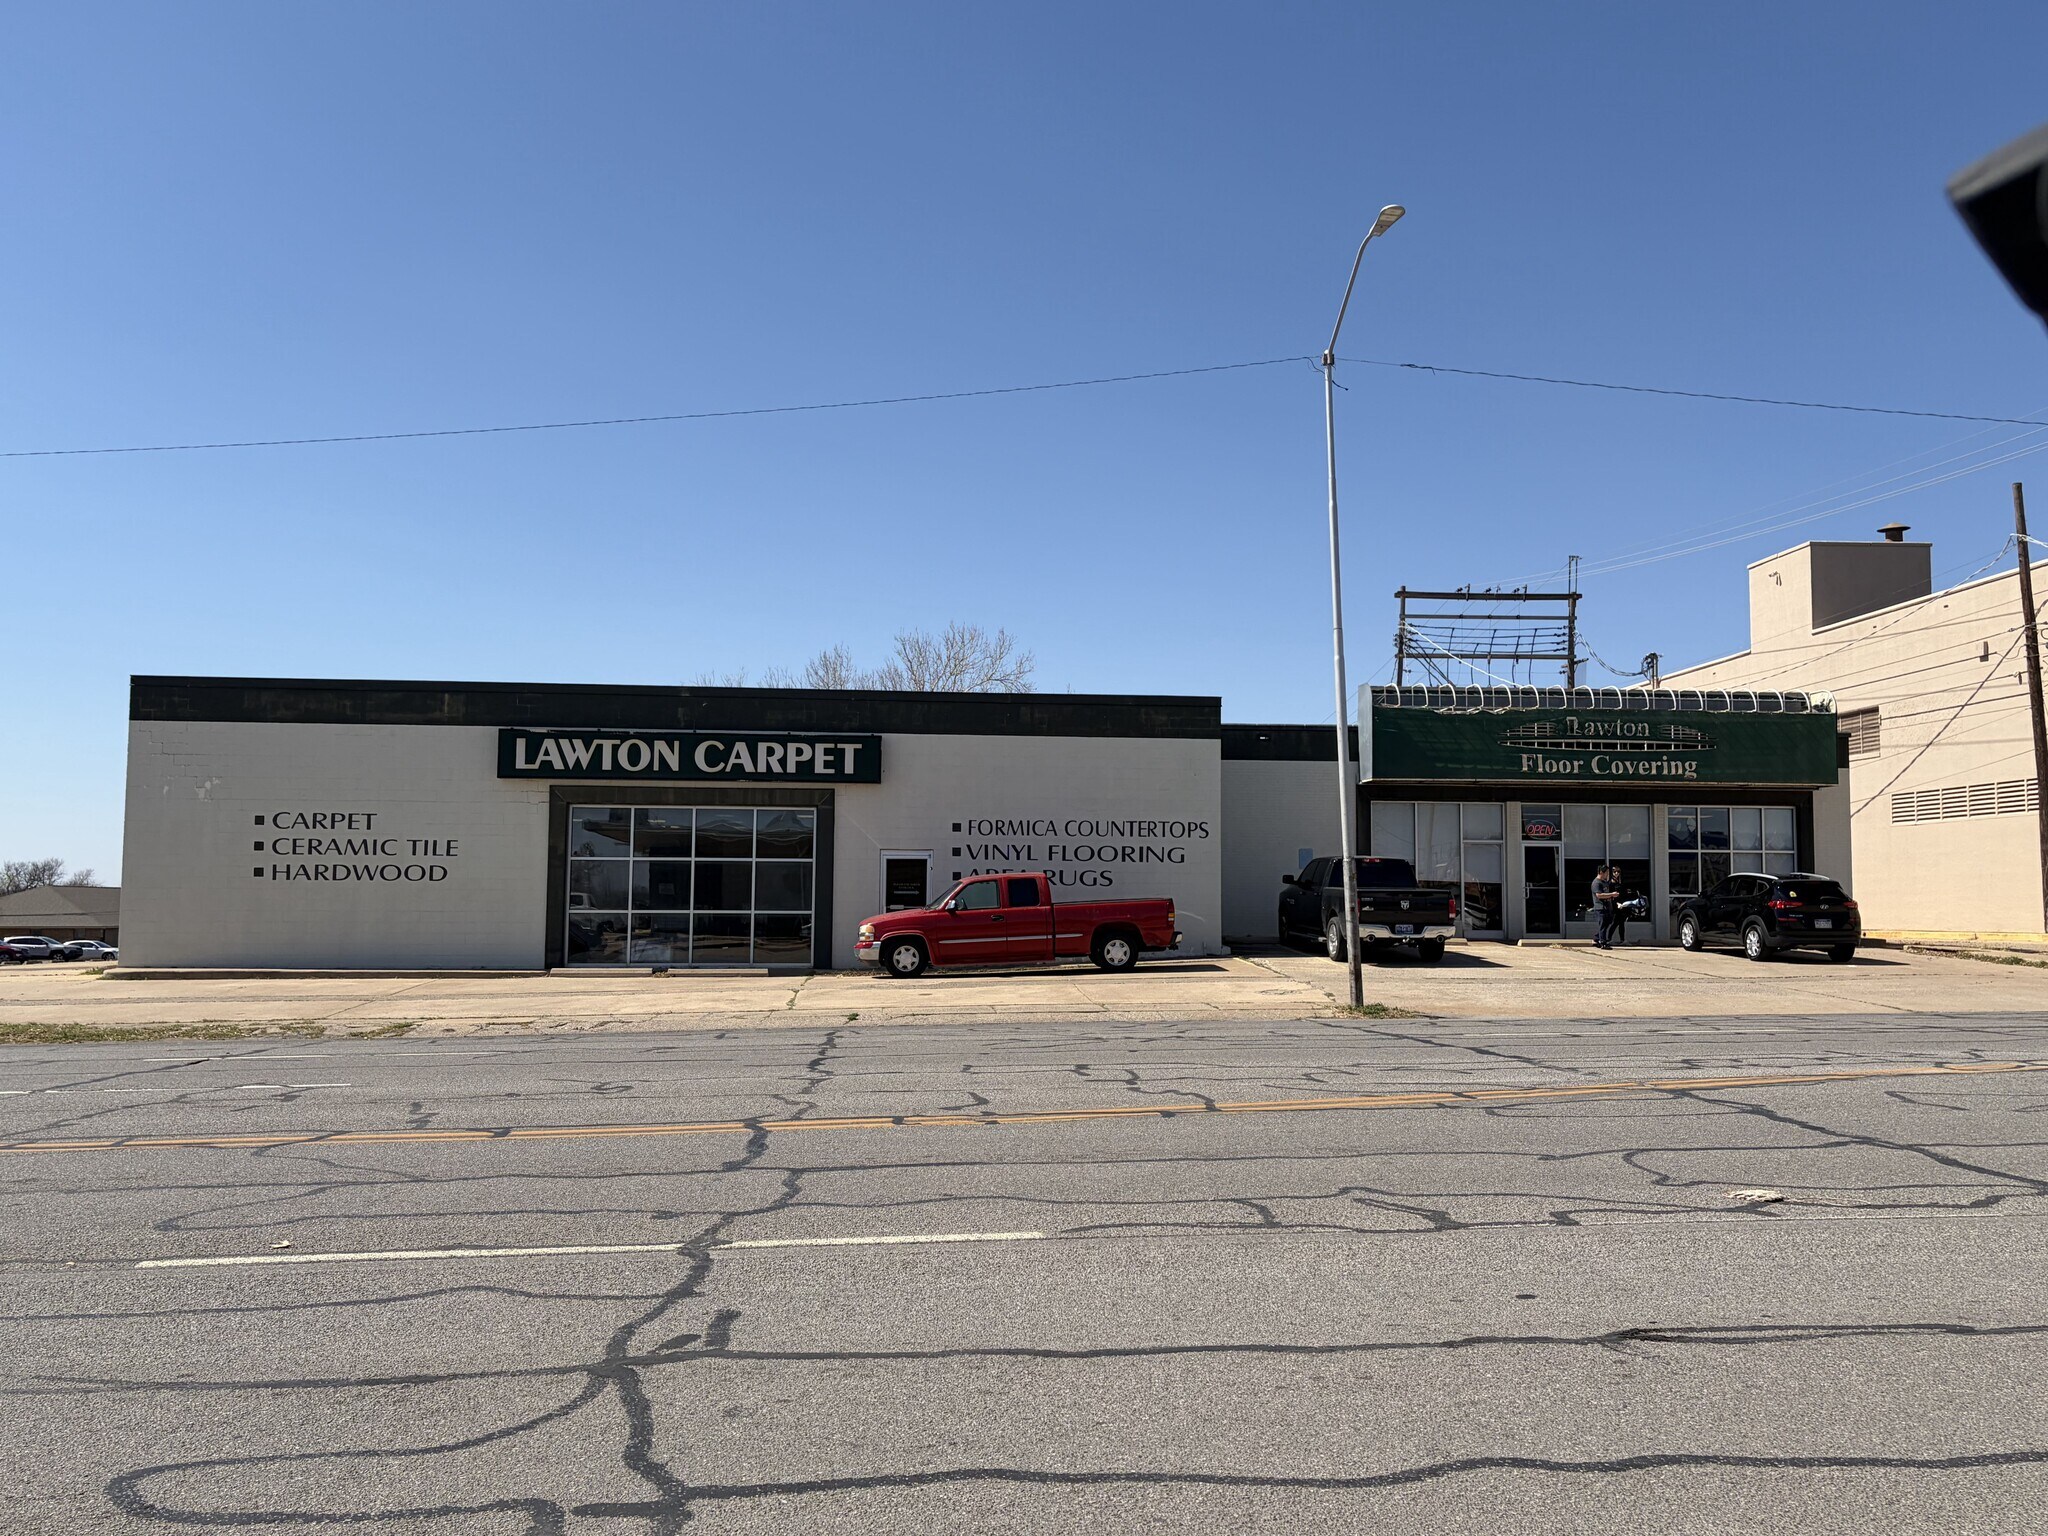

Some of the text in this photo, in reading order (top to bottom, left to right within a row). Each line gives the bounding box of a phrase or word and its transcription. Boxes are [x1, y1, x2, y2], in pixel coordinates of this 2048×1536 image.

[515, 738, 863, 775] LAWTON CARPET
[1520, 753, 1698, 780] Floor Covering
[271, 811, 377, 831] CARPET
[968, 819, 1210, 840] FORMICA COUNTERTOPS
[1527, 824, 1553, 836] OPEN
[271, 837, 459, 857] CERAMIC TILE
[966, 844, 1185, 864] VINYL FLOORING
[271, 863, 448, 882] HARDWOOD
[1044, 869, 1114, 887] RUGS
